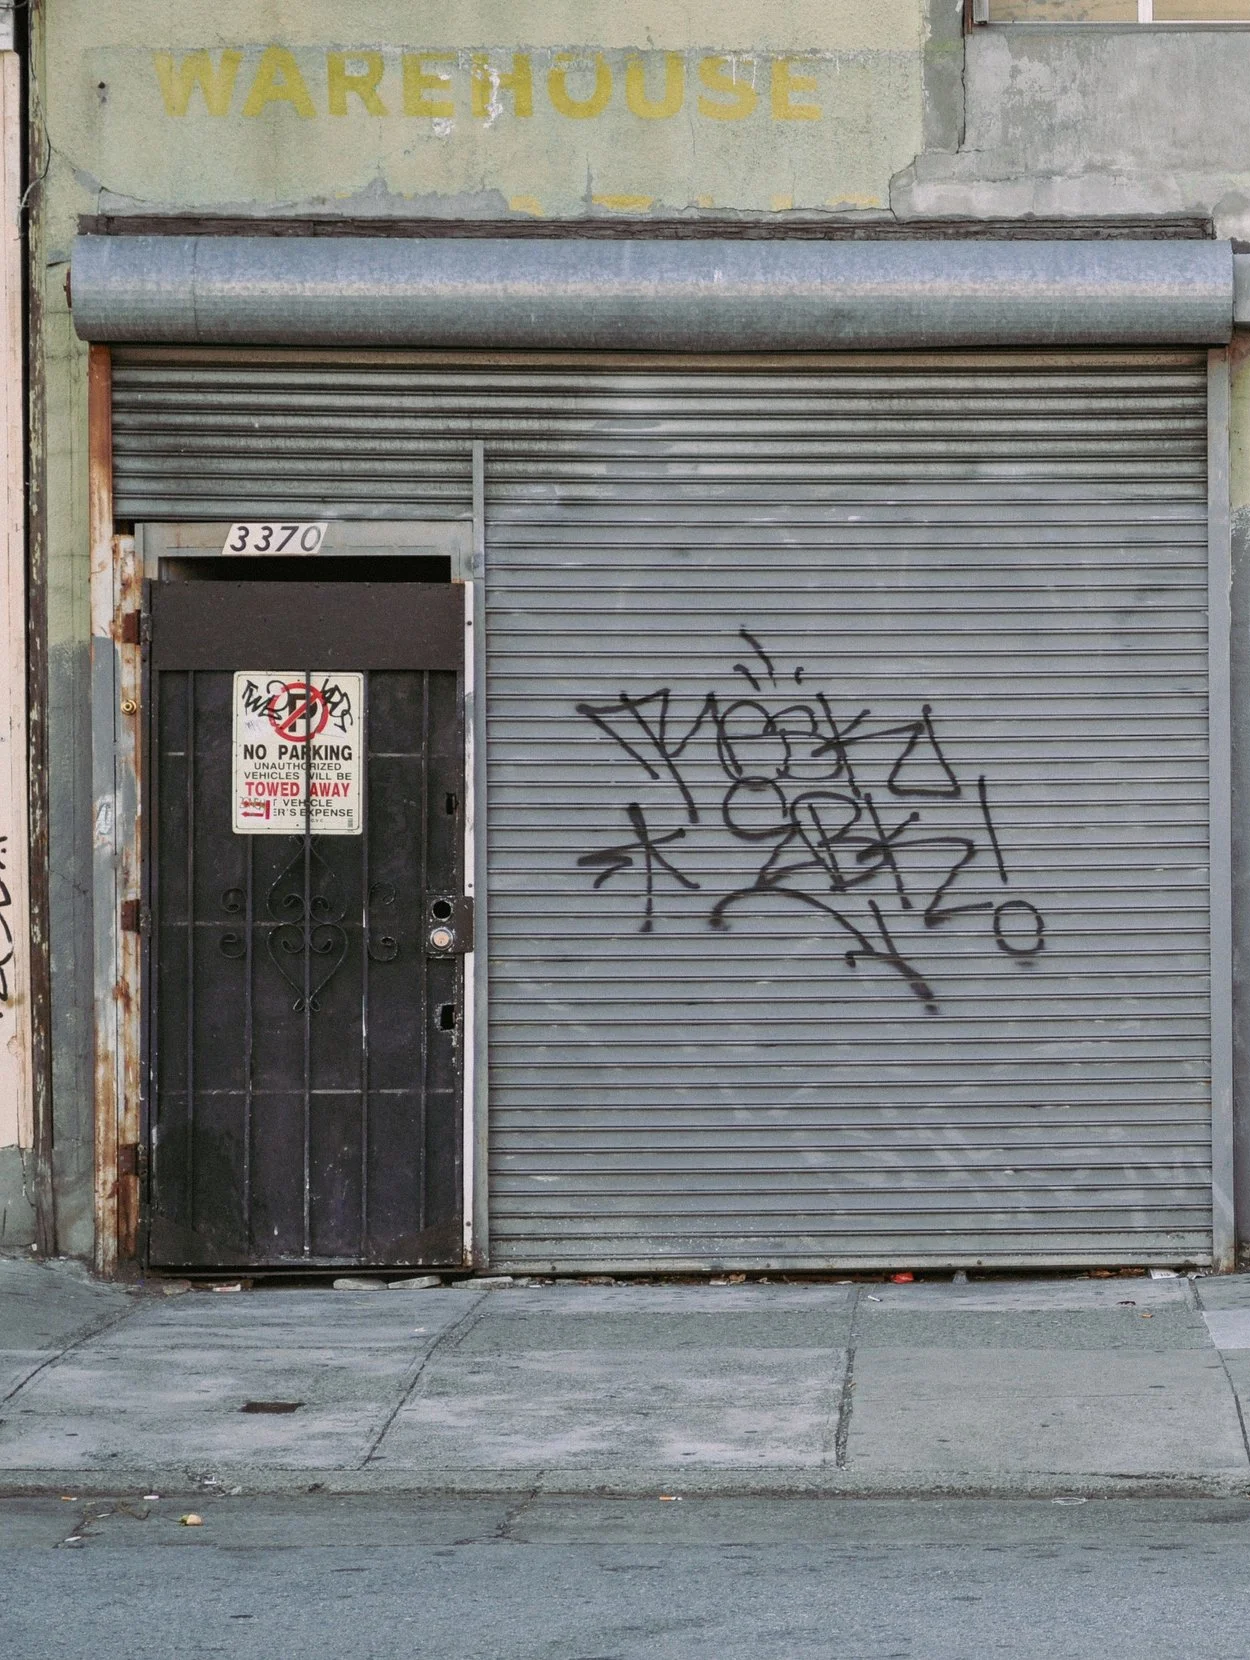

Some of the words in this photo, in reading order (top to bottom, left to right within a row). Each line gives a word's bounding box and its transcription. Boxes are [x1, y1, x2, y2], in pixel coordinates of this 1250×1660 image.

[153, 47, 822, 122] WAREHOUSE
[229, 525, 322, 552] 3370
[243, 744, 267, 760] NO
[278, 744, 353, 761] PARKING
[254, 762, 342, 771] UNAUTHORIZED
[244, 771, 300, 780] VEHICLES
[336, 772, 353, 780] BE
[245, 781, 300, 797] TOWED
[309, 782, 351, 797] AWAY
[282, 799, 333, 808] VEHCLE
